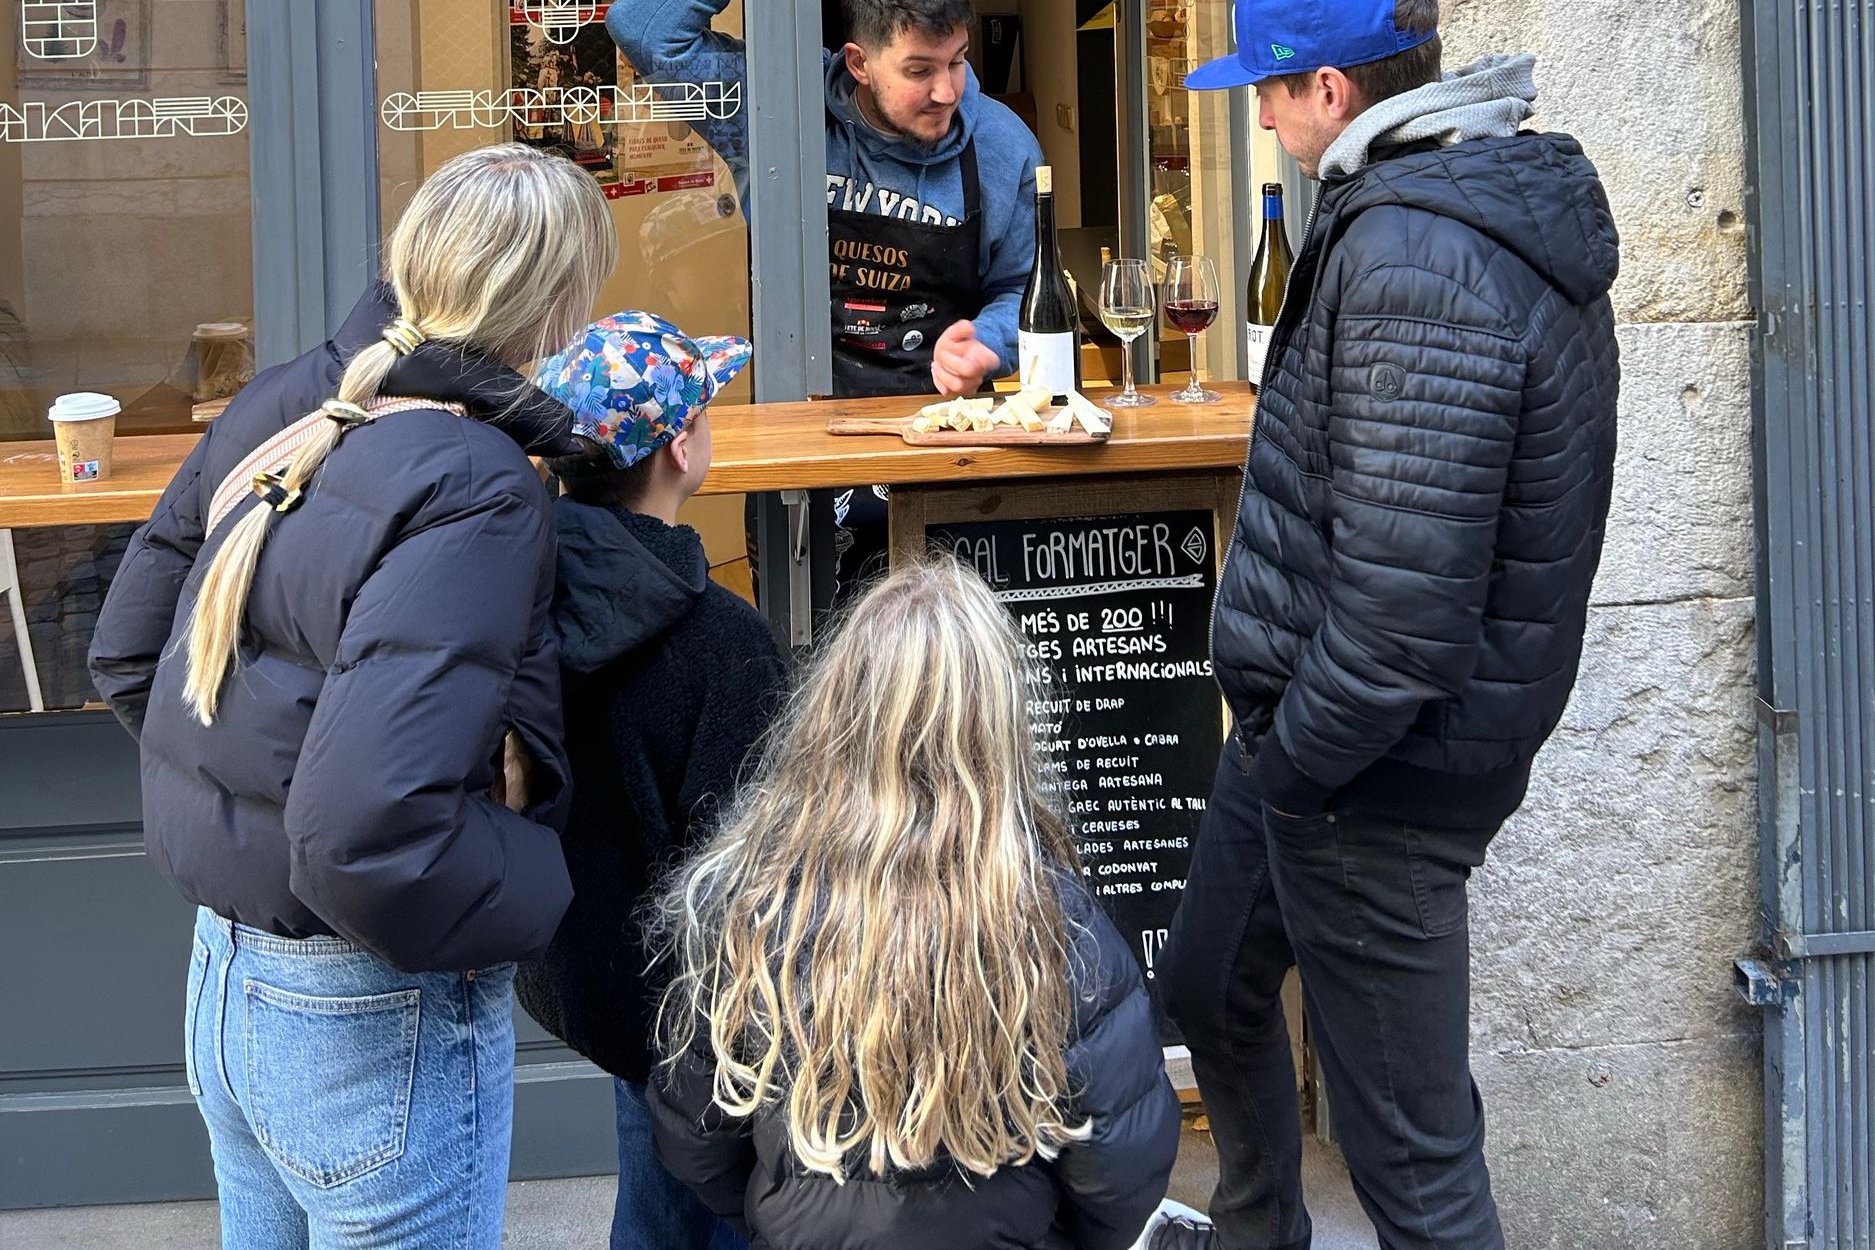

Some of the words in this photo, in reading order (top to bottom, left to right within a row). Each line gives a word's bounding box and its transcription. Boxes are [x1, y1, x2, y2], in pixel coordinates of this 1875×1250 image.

[878, 189, 962, 227] YOR
[834, 239, 908, 268] QUESOS
[856, 267, 911, 291] SUIZA
[1022, 523, 1176, 582] FORMATGER
[1067, 612, 1089, 632] DE
[1101, 607, 1143, 632] 200
[1072, 634, 1167, 658] ARTESANS
[1076, 699, 1091, 712] DE
[1095, 698, 1125, 710] DRAP
[1077, 735, 1127, 749] D'OVELLA
[1144, 734, 1179, 746] CABRA
[1076, 758, 1090, 770] DE
[1099, 773, 1163, 788] ARTESANA
[1068, 799, 1100, 813] GREC
[1082, 820, 1140, 834] CERVESES
[1123, 836, 1189, 851] ARTESANES
[1103, 883, 1143, 895] ALTRES
